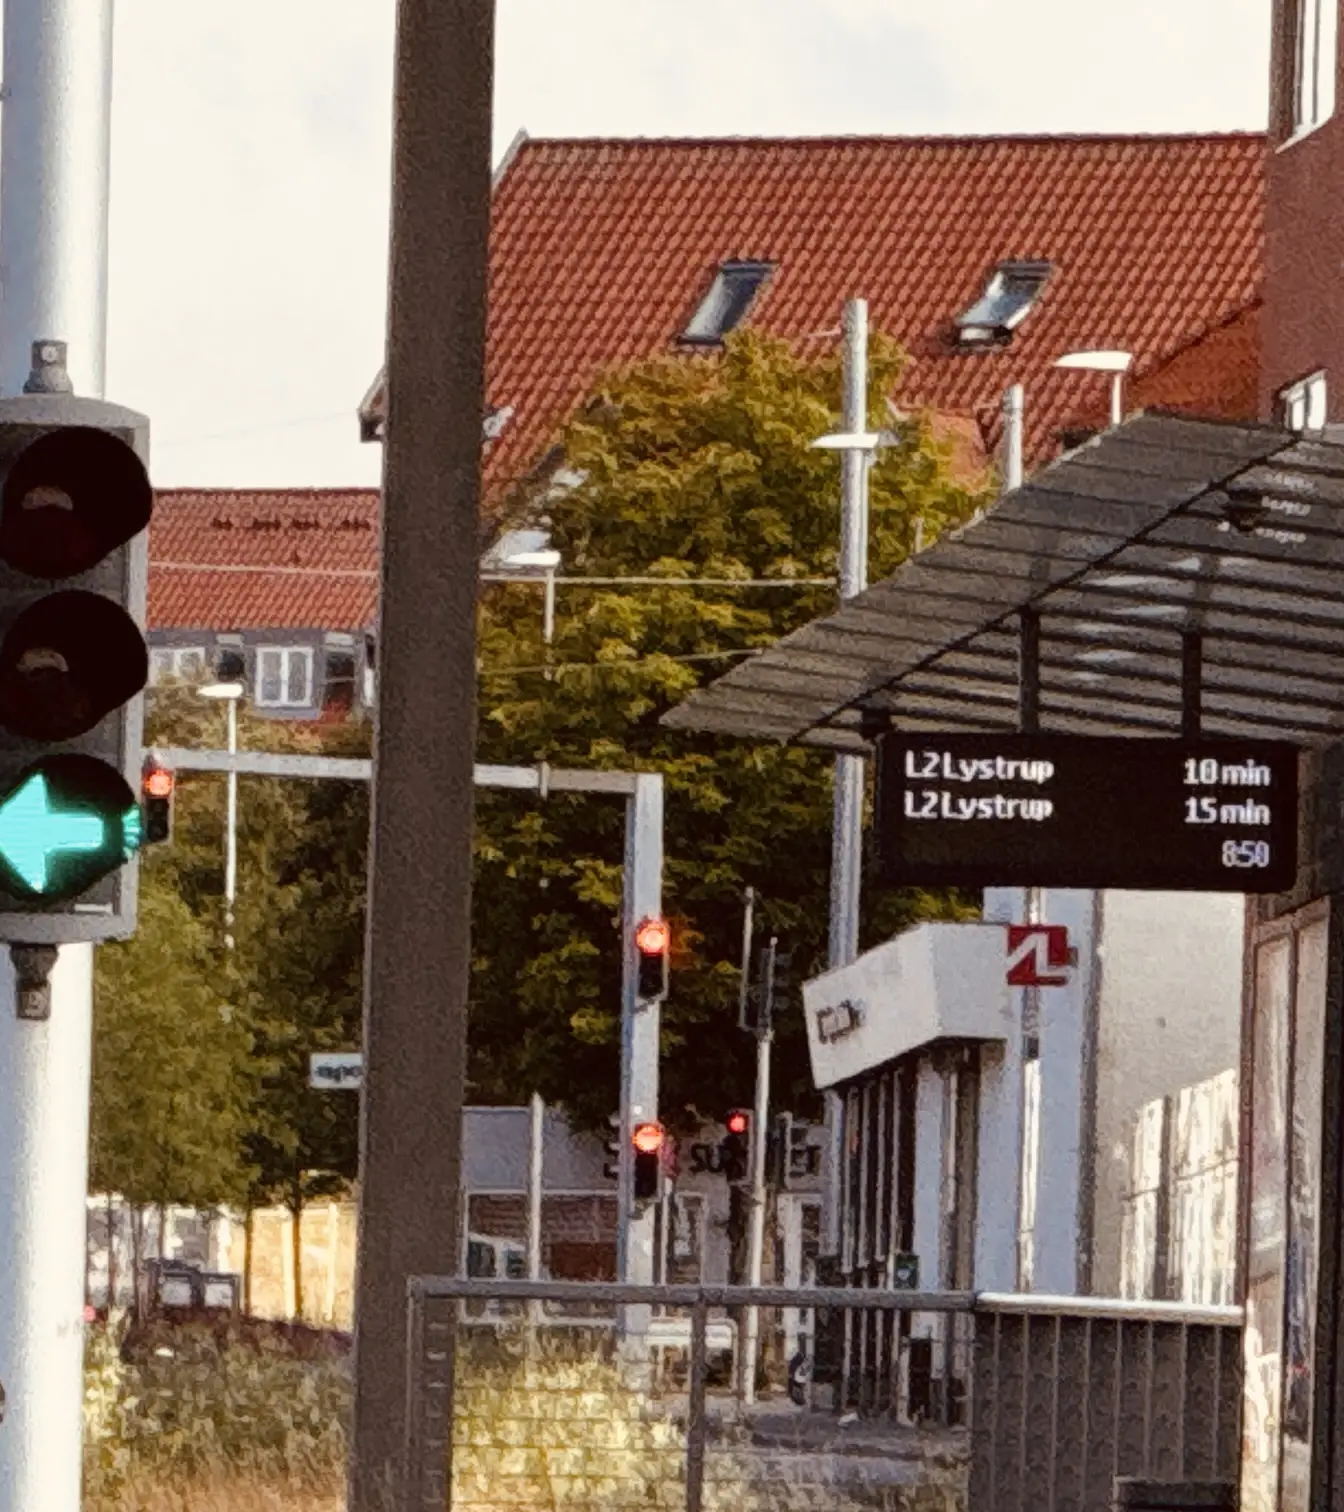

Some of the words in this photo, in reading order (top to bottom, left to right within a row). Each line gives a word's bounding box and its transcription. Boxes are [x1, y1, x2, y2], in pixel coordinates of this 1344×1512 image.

[943, 751, 1055, 784] Lystrup
[1184, 758, 1218, 785] 10
[1221, 759, 1271, 786] min
[941, 791, 1053, 821] Lystrup
[1184, 796, 1218, 824] 15
[1220, 798, 1271, 825] min
